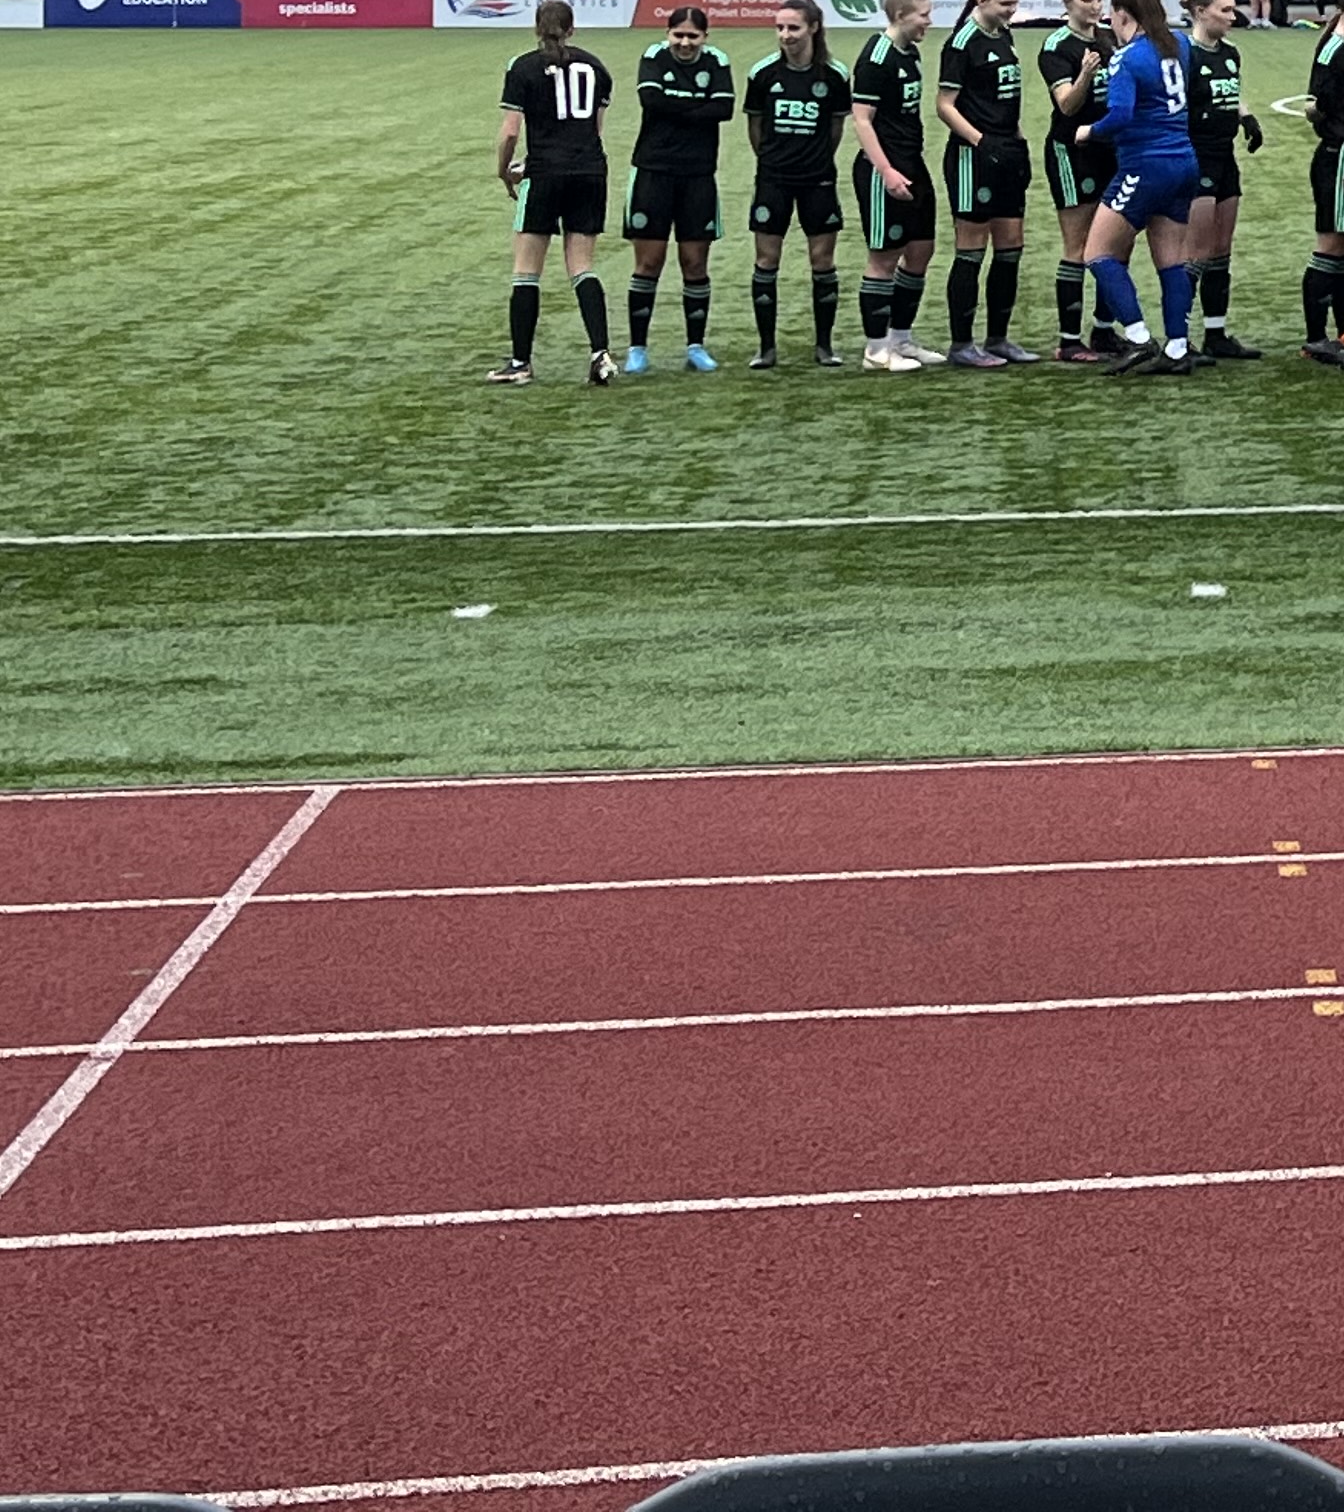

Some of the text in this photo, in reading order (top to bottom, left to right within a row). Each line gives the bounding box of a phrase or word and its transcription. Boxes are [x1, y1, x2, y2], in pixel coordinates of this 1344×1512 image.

[278, 1, 357, 16] specialists
[545, 62, 596, 120] 10
[1160, 58, 1187, 115] 9
[774, 99, 820, 120] FBS
